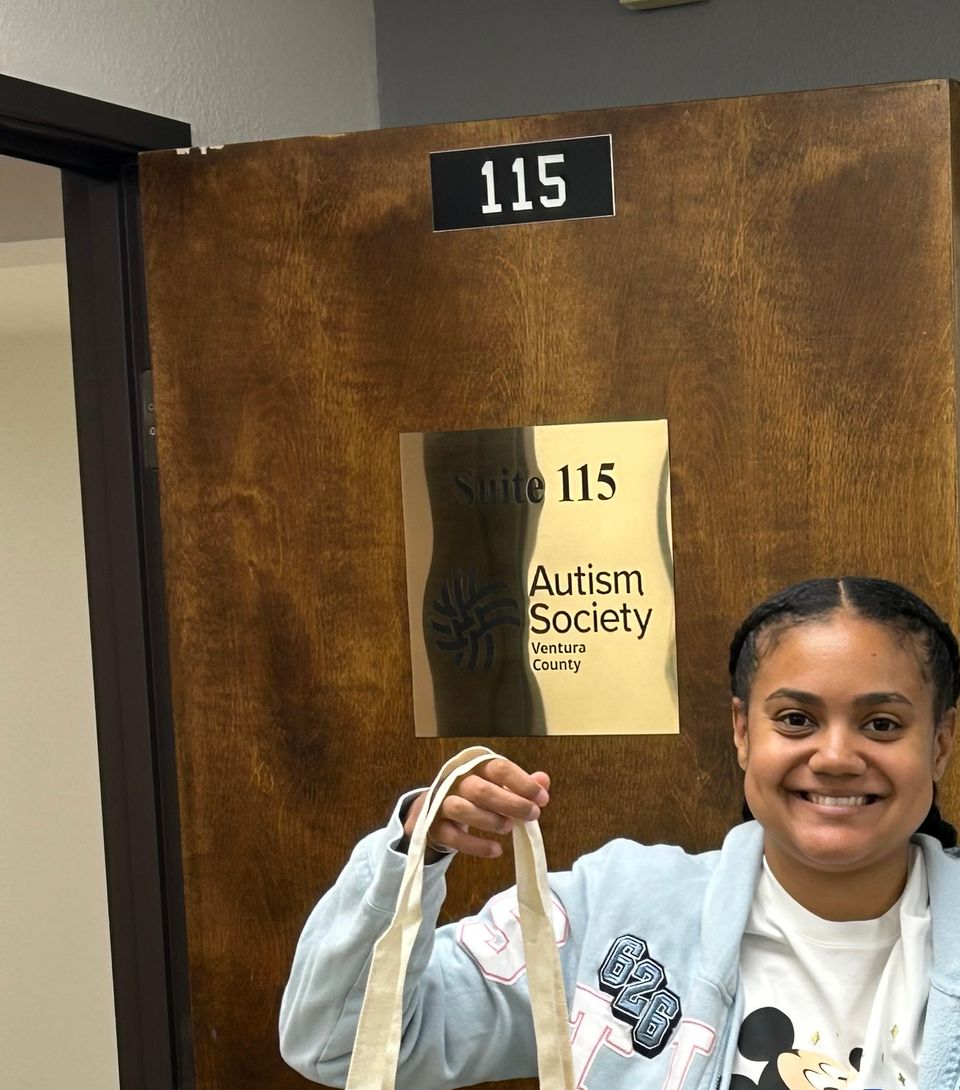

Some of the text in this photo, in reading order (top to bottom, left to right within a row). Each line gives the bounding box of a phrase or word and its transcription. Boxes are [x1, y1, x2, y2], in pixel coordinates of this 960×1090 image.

[481, 153, 567, 214] 115
[455, 462, 617, 506] Suite 115
[529, 563, 645, 597] Autism
[530, 601, 653, 640] Society
[531, 642, 586, 655] Ventura
[532, 658, 581, 674] County
[598, 934, 682, 1058] 626
